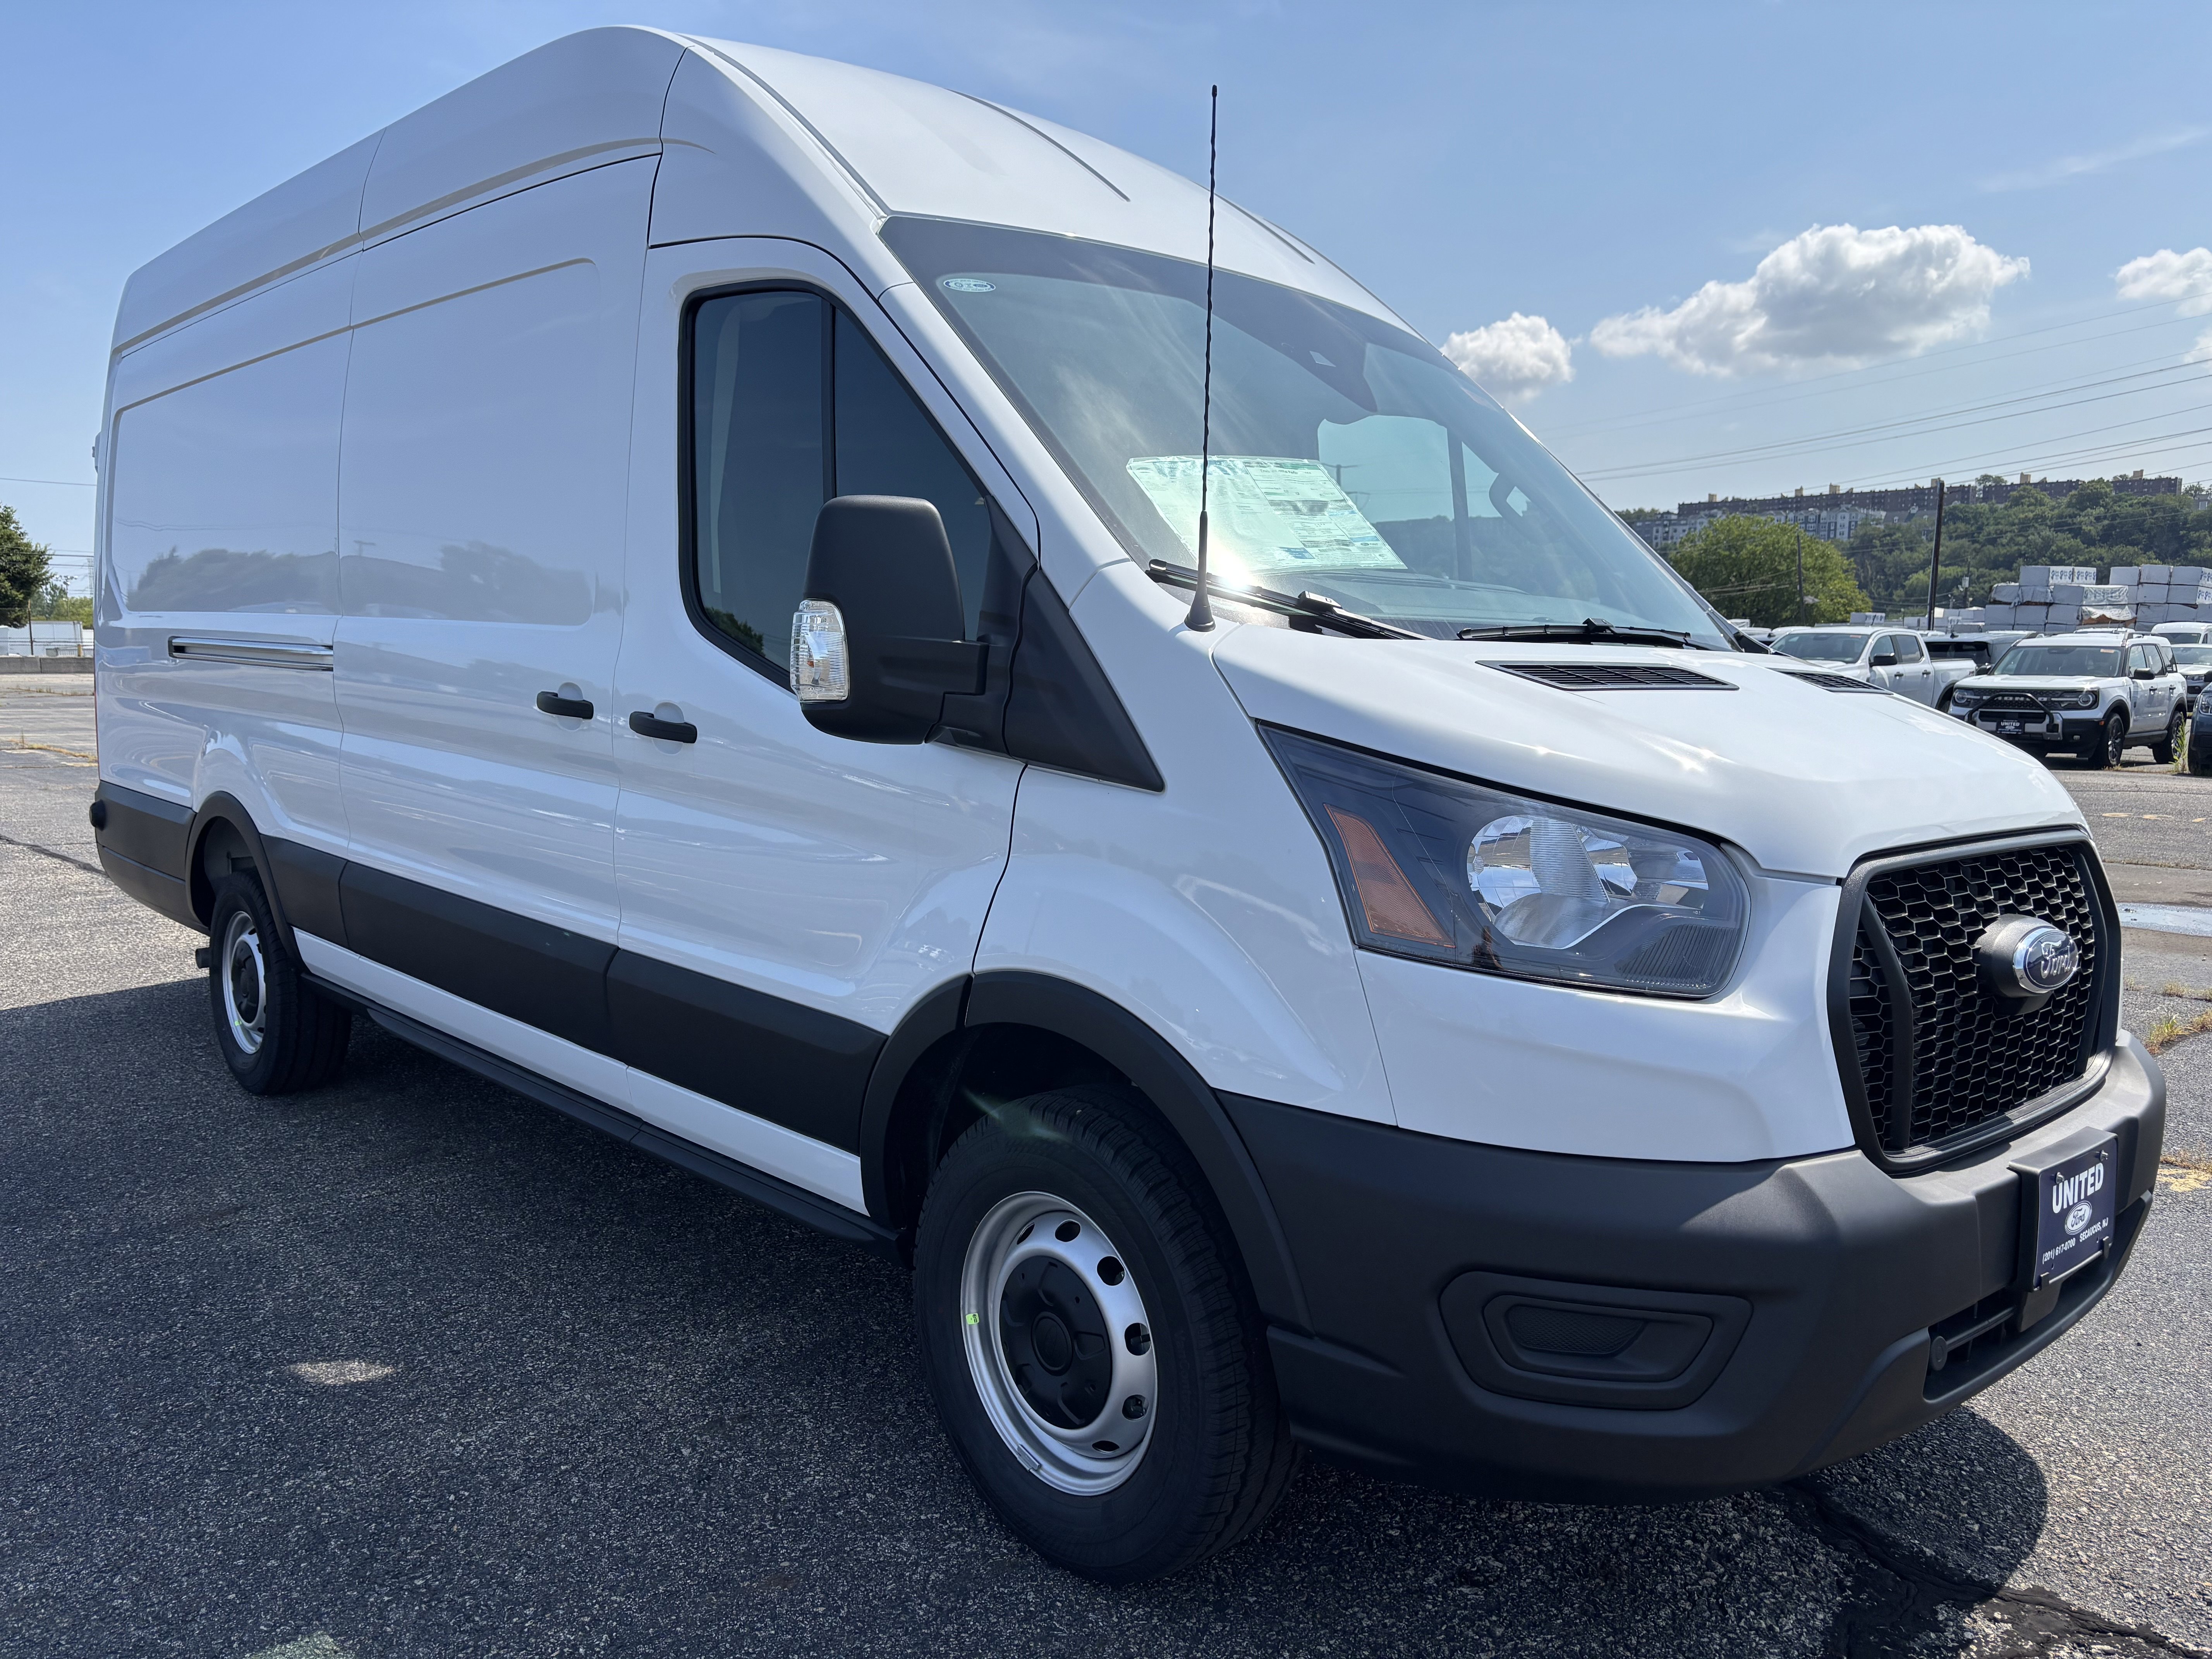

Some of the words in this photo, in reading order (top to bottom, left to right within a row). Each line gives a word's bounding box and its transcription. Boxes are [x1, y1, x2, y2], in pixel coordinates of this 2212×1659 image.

[2040, 940, 2072, 979] Ford
[2052, 1163, 2104, 1213] UNITED
[2071, 1207, 2086, 1228] Ford
[2042, 1248, 2055, 1264] (201)
[2055, 1238, 2076, 1255] 617-0700
[2079, 1221, 2102, 1242] SECAUCUS,
[2102, 1217, 2109, 1228] NJ
